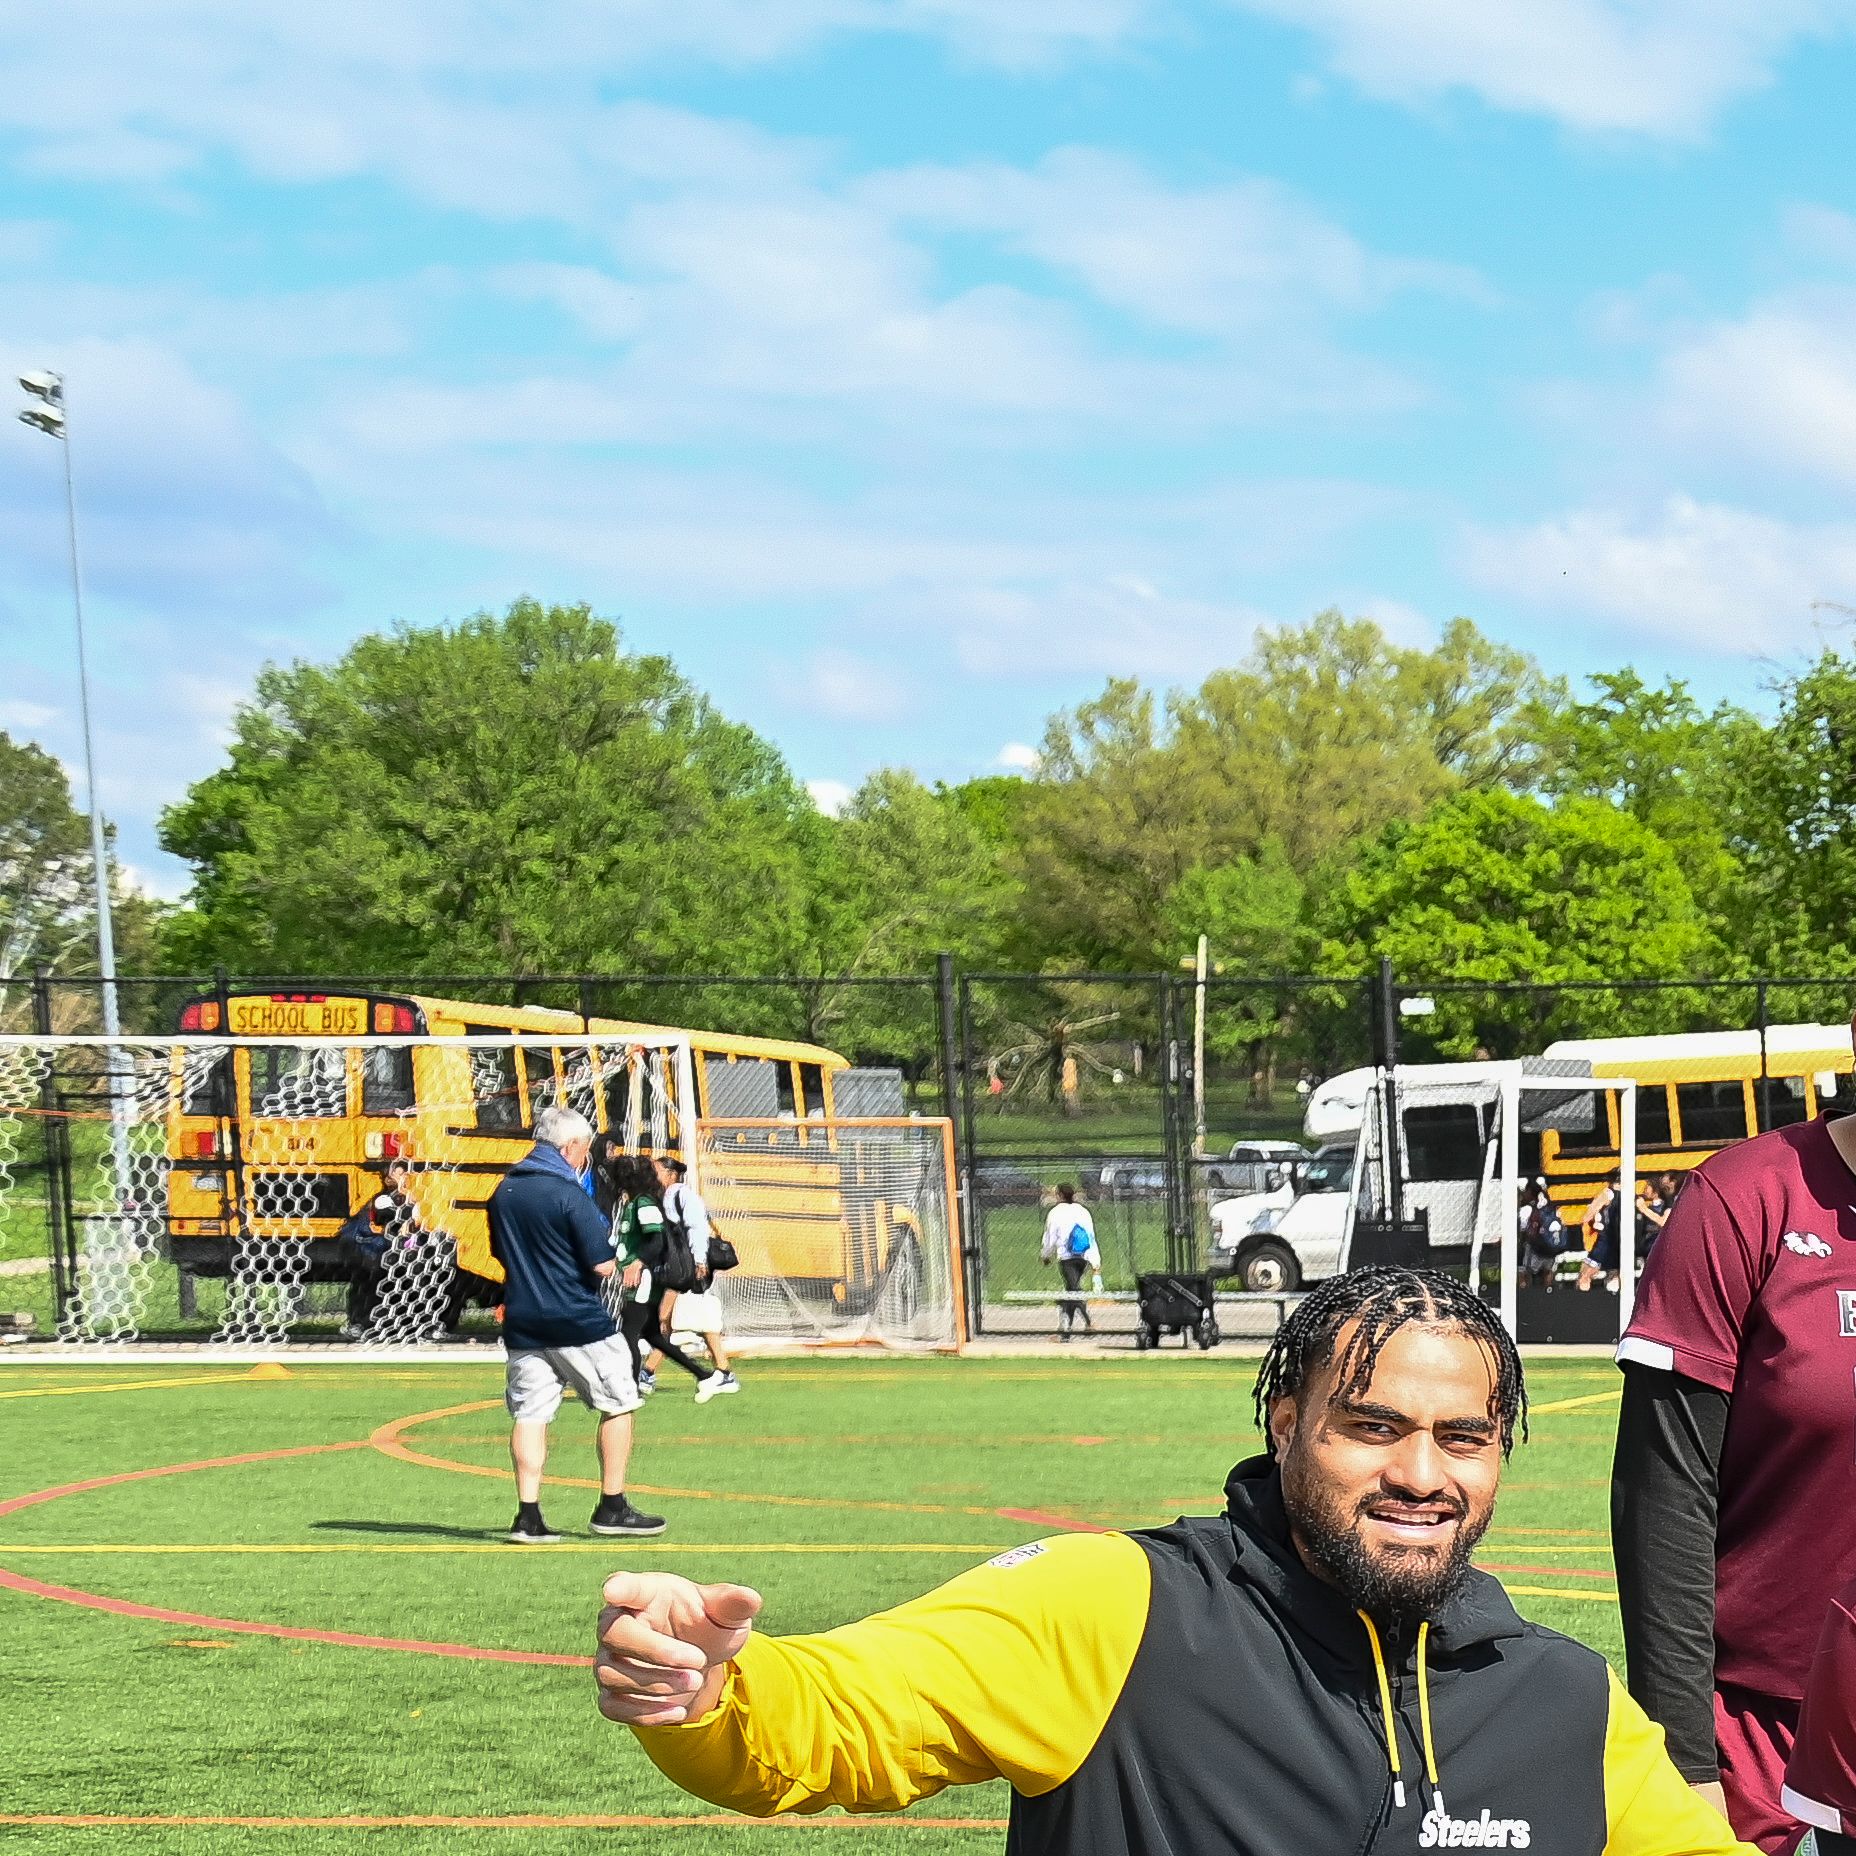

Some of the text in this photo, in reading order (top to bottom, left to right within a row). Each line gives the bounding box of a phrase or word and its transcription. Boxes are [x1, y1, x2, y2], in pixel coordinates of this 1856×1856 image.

[236, 1005, 358, 1033] SCHOOL BUS
[1418, 1808, 1531, 1849] Steelers
